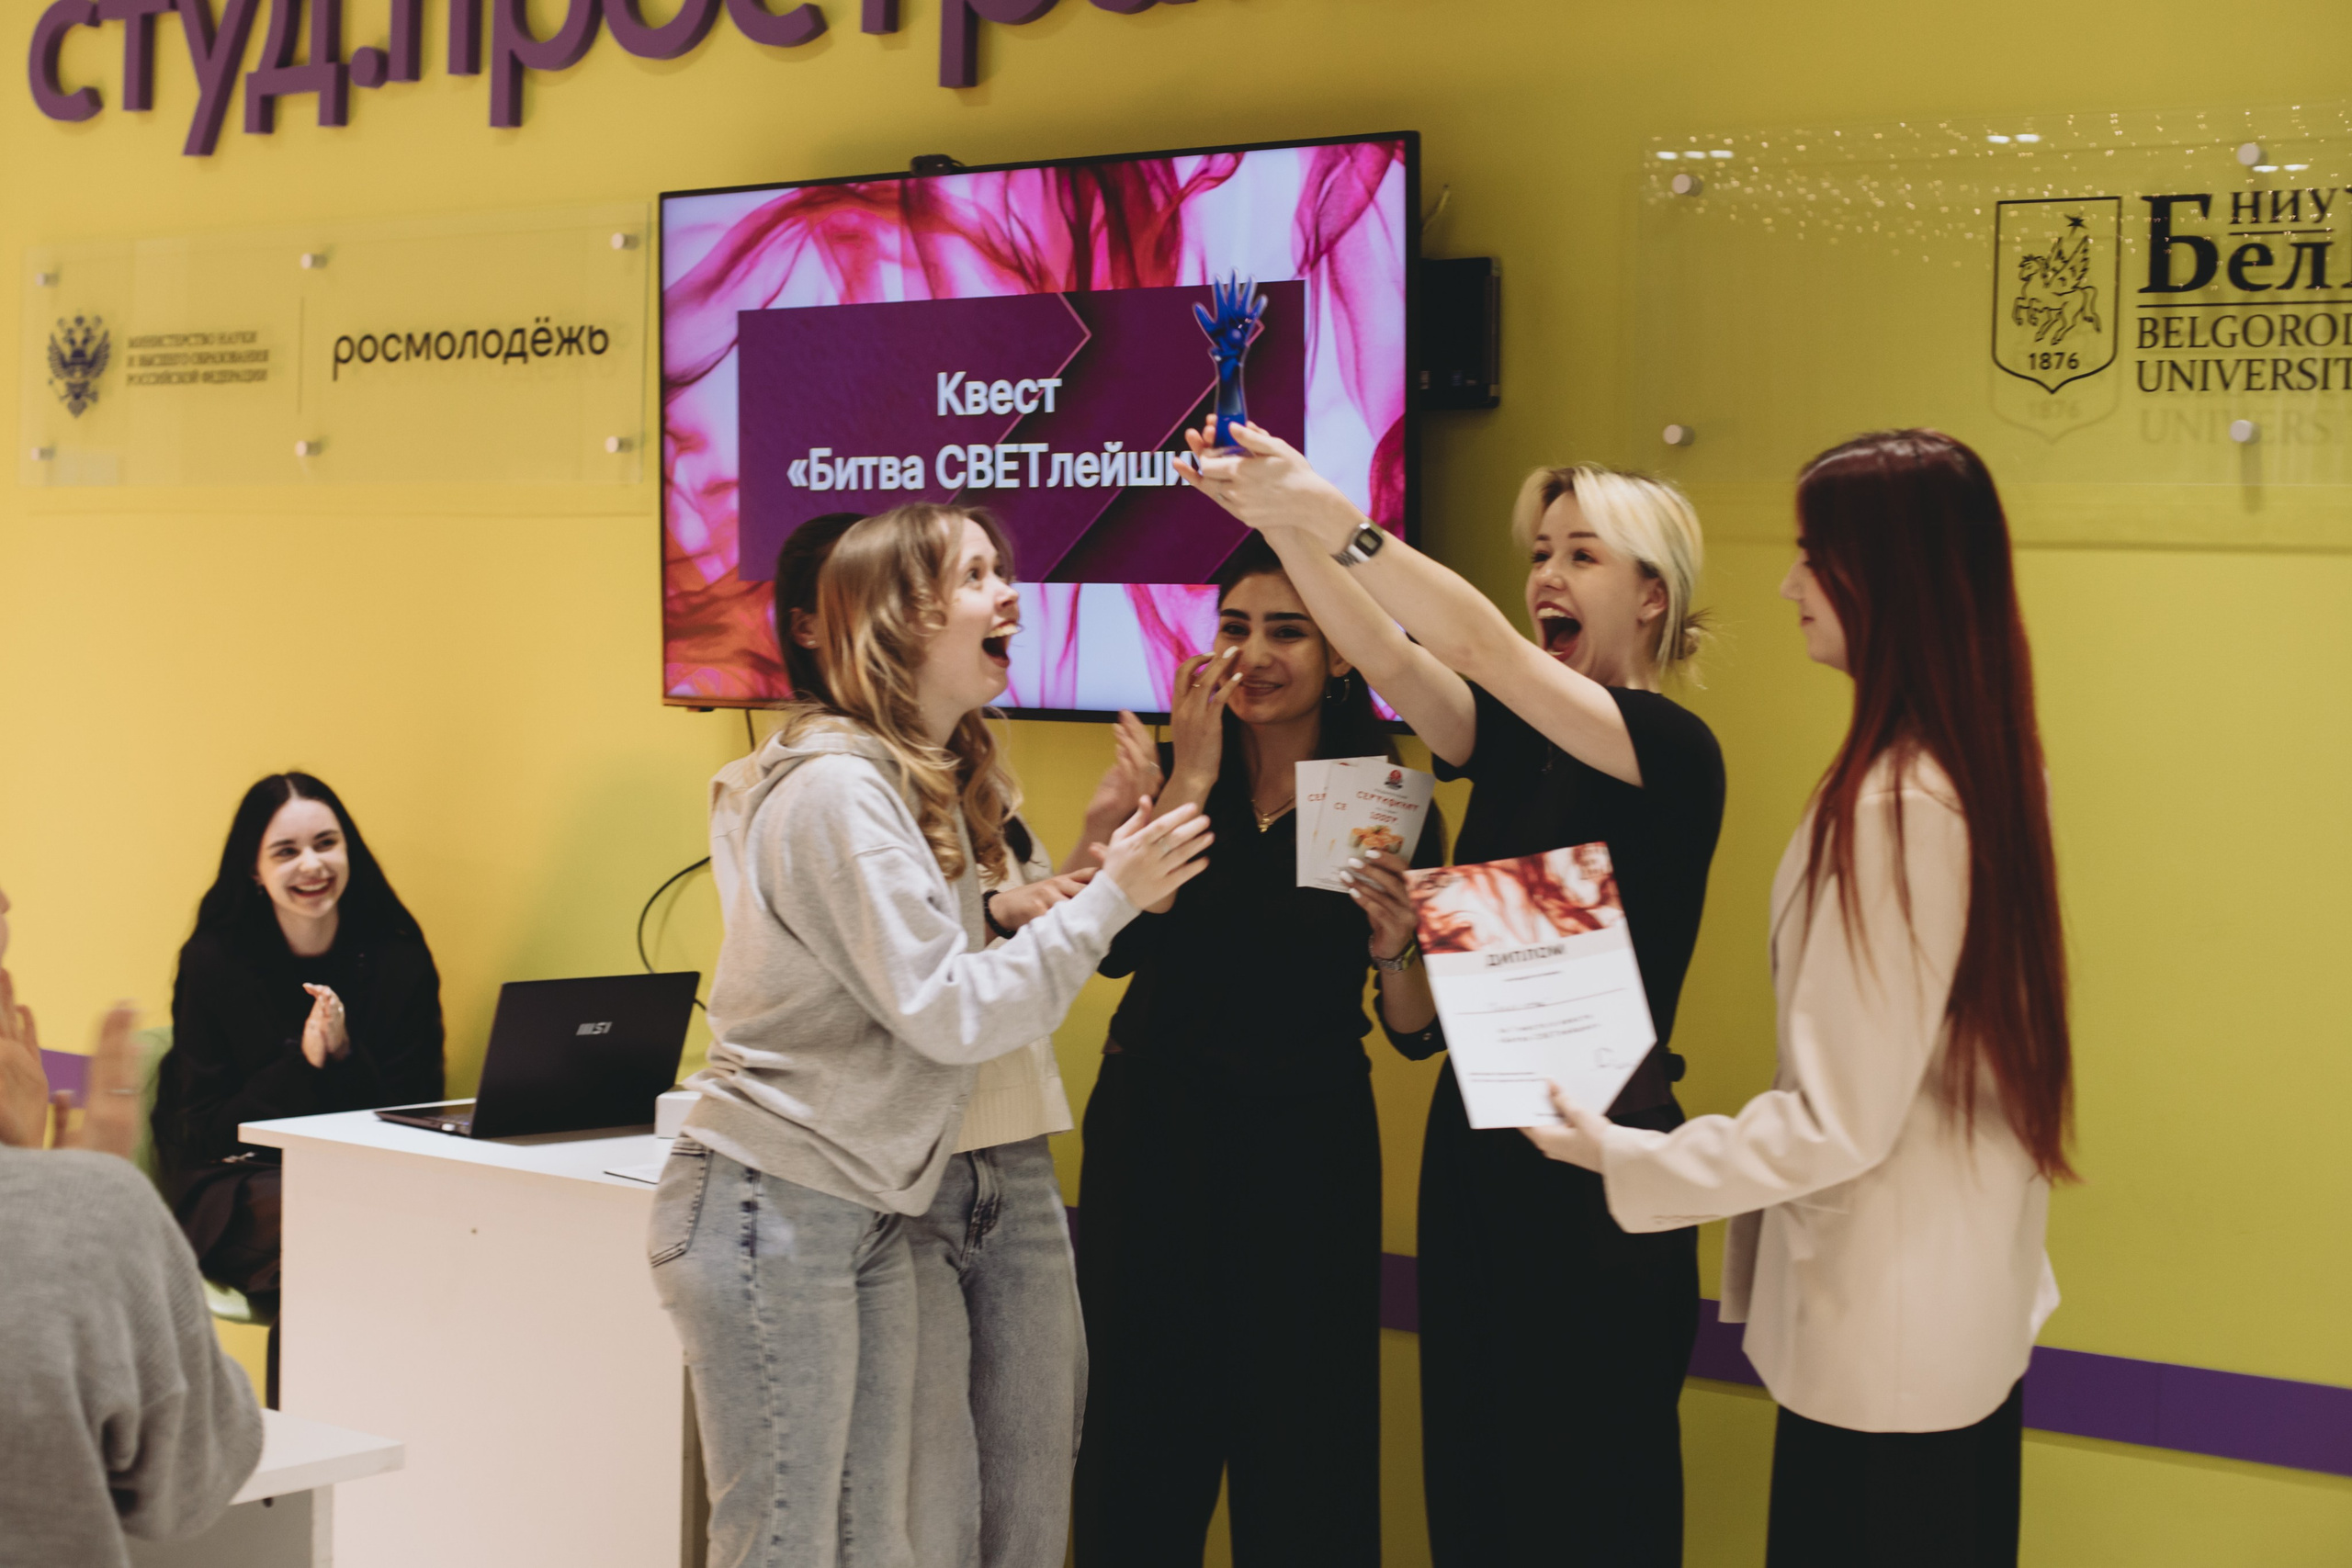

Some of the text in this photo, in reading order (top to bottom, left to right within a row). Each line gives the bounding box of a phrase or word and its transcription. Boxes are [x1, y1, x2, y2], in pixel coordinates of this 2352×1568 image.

[2229, 188, 2337, 225] НИУ
[2137, 188, 2352, 294] Бел
[333, 316, 609, 382] росмолодёжь
[2029, 352, 2079, 370] 1876
[936, 370, 1062, 417] Квест
[786, 441, 1204, 491] «Битва СВЕТлейши
